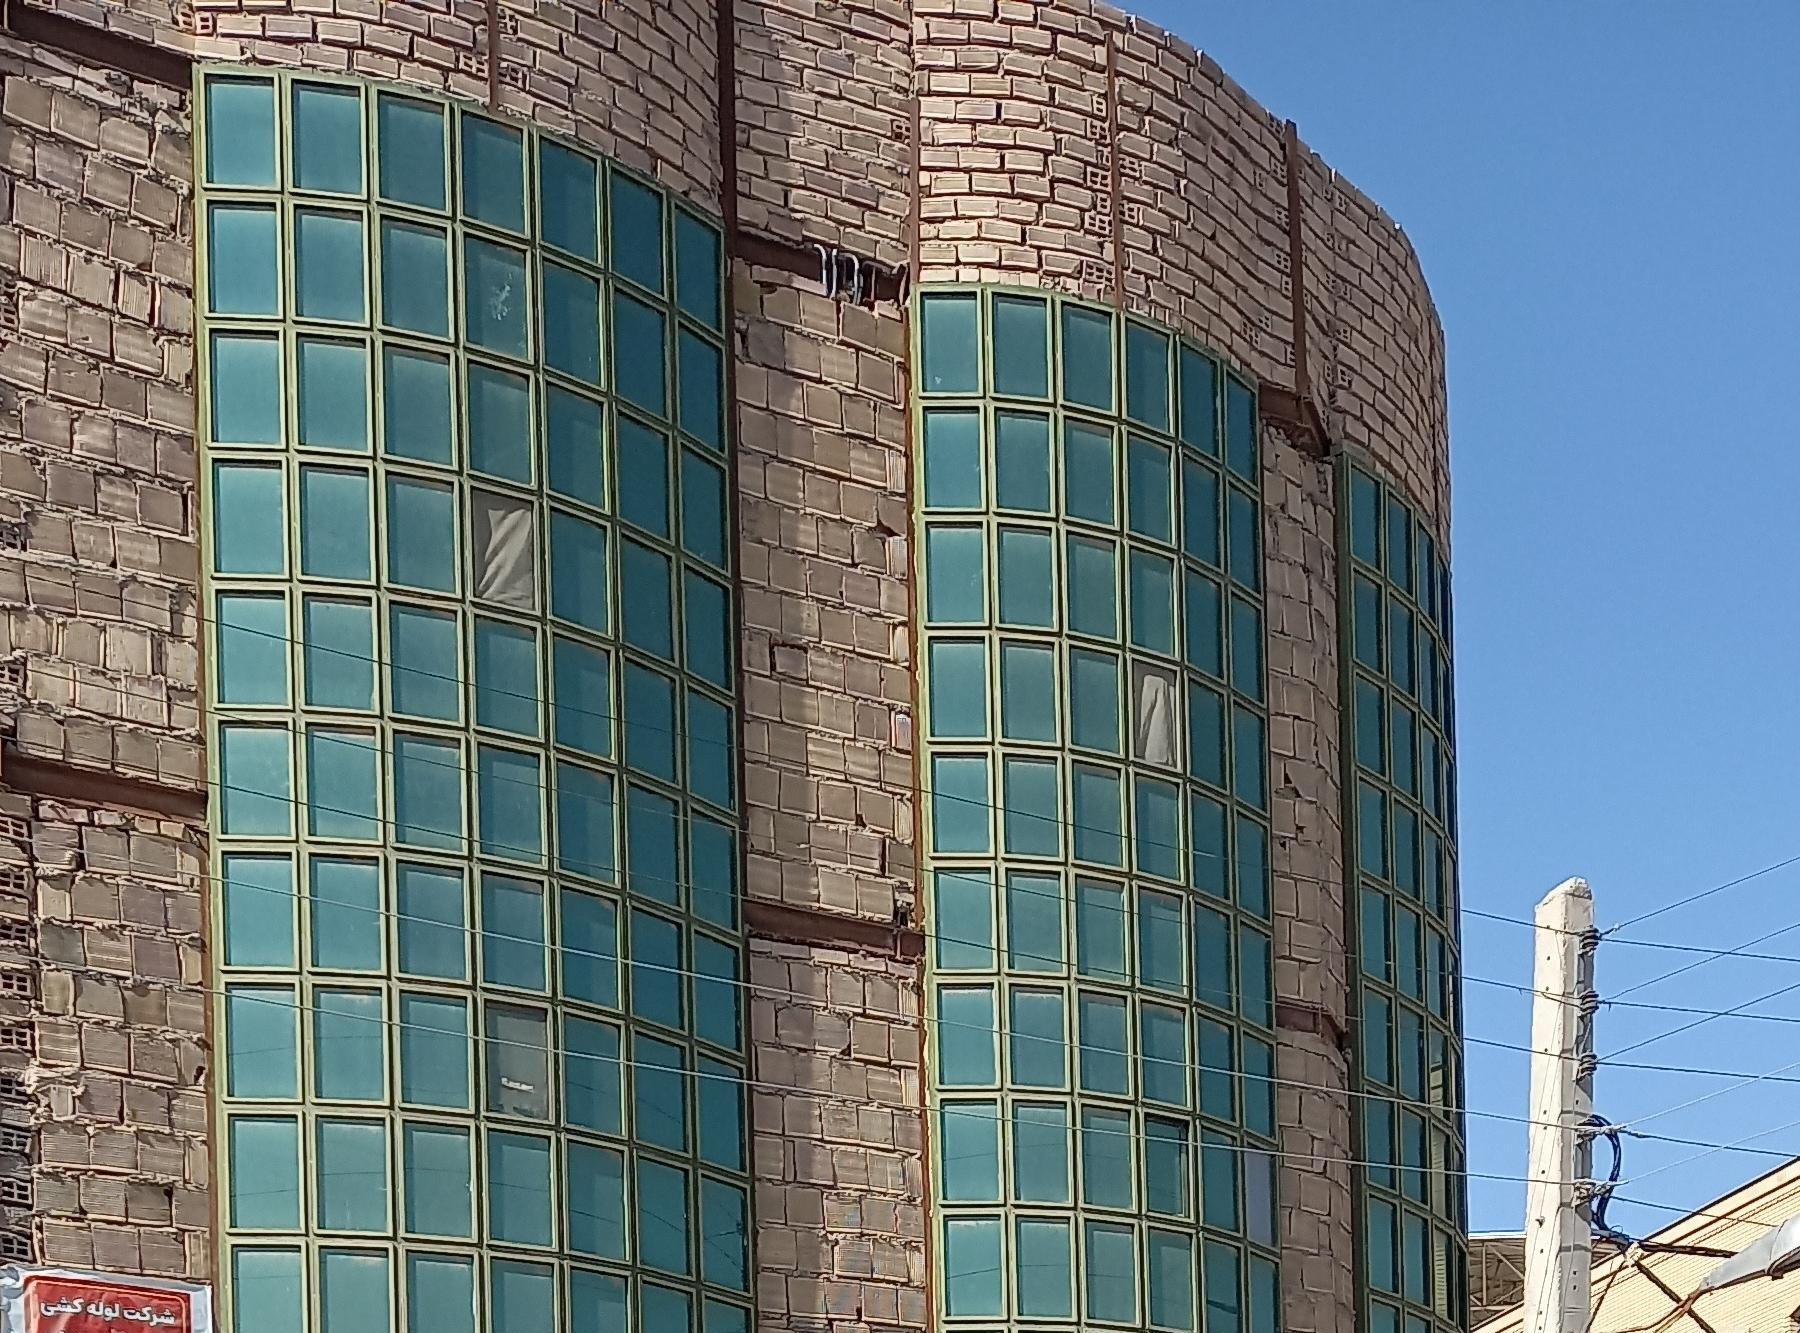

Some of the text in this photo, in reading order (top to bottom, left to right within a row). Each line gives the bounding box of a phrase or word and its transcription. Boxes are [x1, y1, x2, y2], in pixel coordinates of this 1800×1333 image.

[41, 1297, 175, 1326] شرکت لوله کشی
